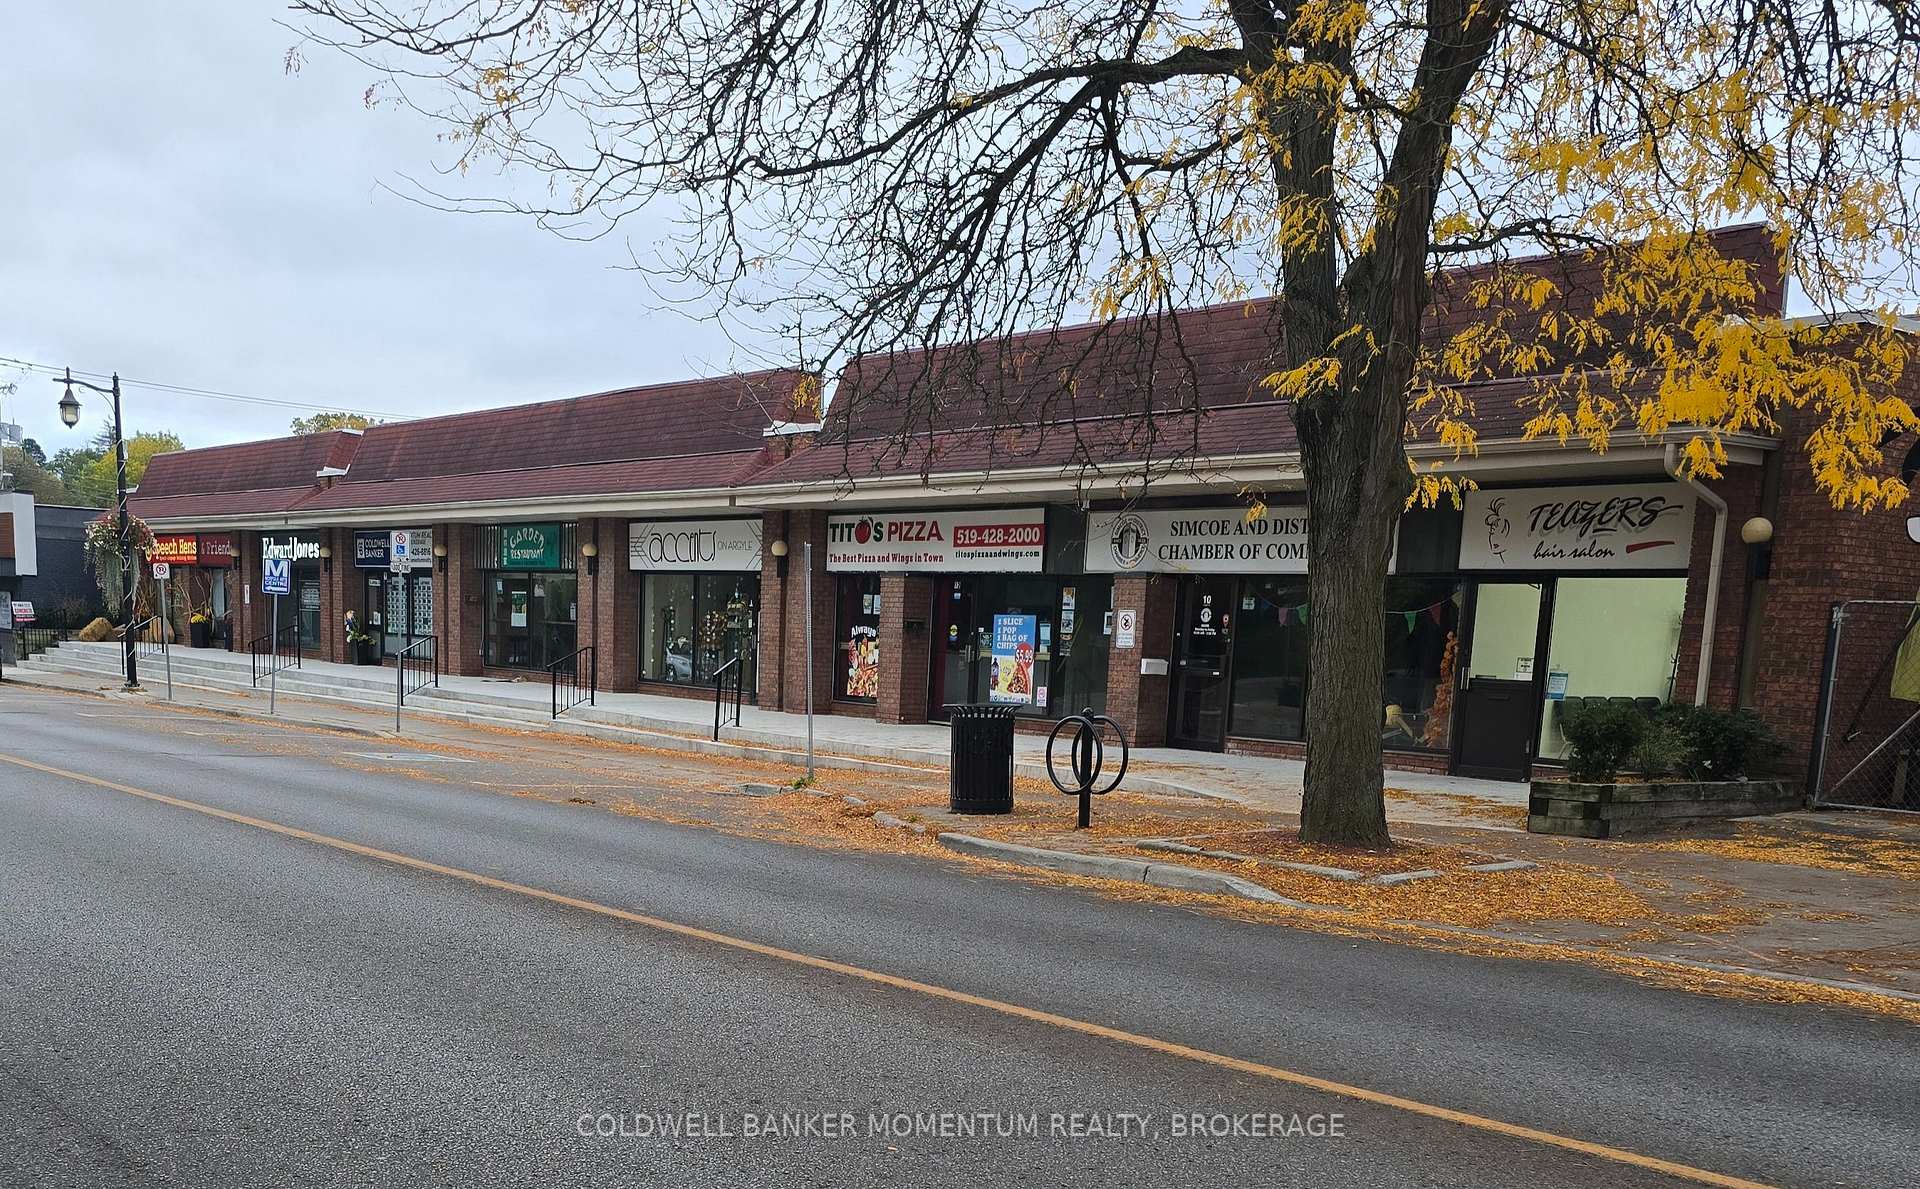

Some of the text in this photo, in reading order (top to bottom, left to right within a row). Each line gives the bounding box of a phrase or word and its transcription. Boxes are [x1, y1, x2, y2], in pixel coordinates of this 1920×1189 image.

[887, 521, 944, 542] PIZZA
[1170, 518, 1309, 537] SIMCOE AND DIST
[510, 527, 544, 549] GARDEN
[957, 527, 1040, 544] 519-428-2000
[179, 538, 197, 555] Hens
[206, 540, 232, 555] Friend
[365, 539, 391, 548] COLDWELL
[728, 541, 753, 550] ARGYLE
[1533, 540, 1616, 559] hair salon
[365, 549, 385, 558] BANKER
[510, 549, 545, 559] RESTAURANT
[955, 549, 1040, 559] titospizzaandwings.com
[1158, 543, 1235, 560] CHAMBER
[1240, 543, 1262, 559] OF
[829, 552, 944, 565] The Best Pizza and Wings in Town
[1203, 595, 1212, 604] 10
[1003, 617, 1024, 625] SLICE
[851, 625, 877, 638] Always
[1018, 634, 1028, 642] OF
